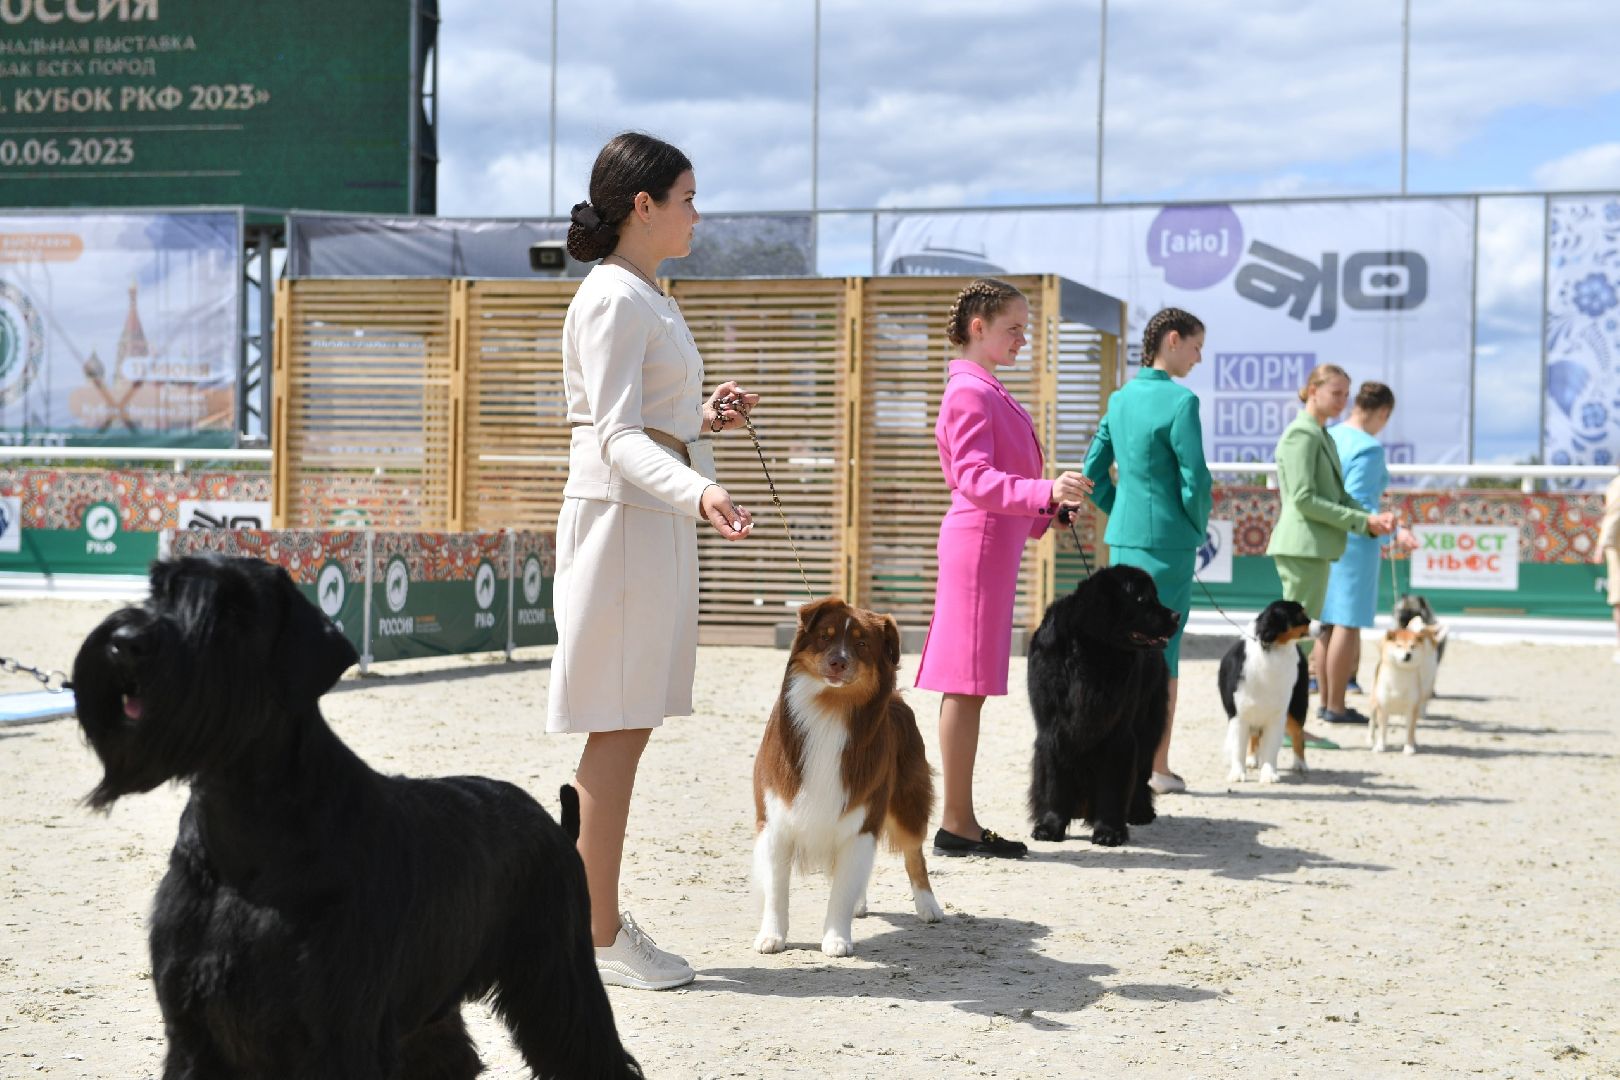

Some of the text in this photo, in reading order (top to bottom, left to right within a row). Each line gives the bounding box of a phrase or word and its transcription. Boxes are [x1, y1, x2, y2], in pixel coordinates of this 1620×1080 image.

[94, 35, 196, 53] ВЫСТАВКА
[14, 87, 113, 113] КУБОК
[120, 86, 183, 111] РКФ
[1217, 354, 1305, 390] КОРМ
[1423, 532, 1507, 552] ХВОСТ
[379, 616, 414, 636] РОССИЯ
